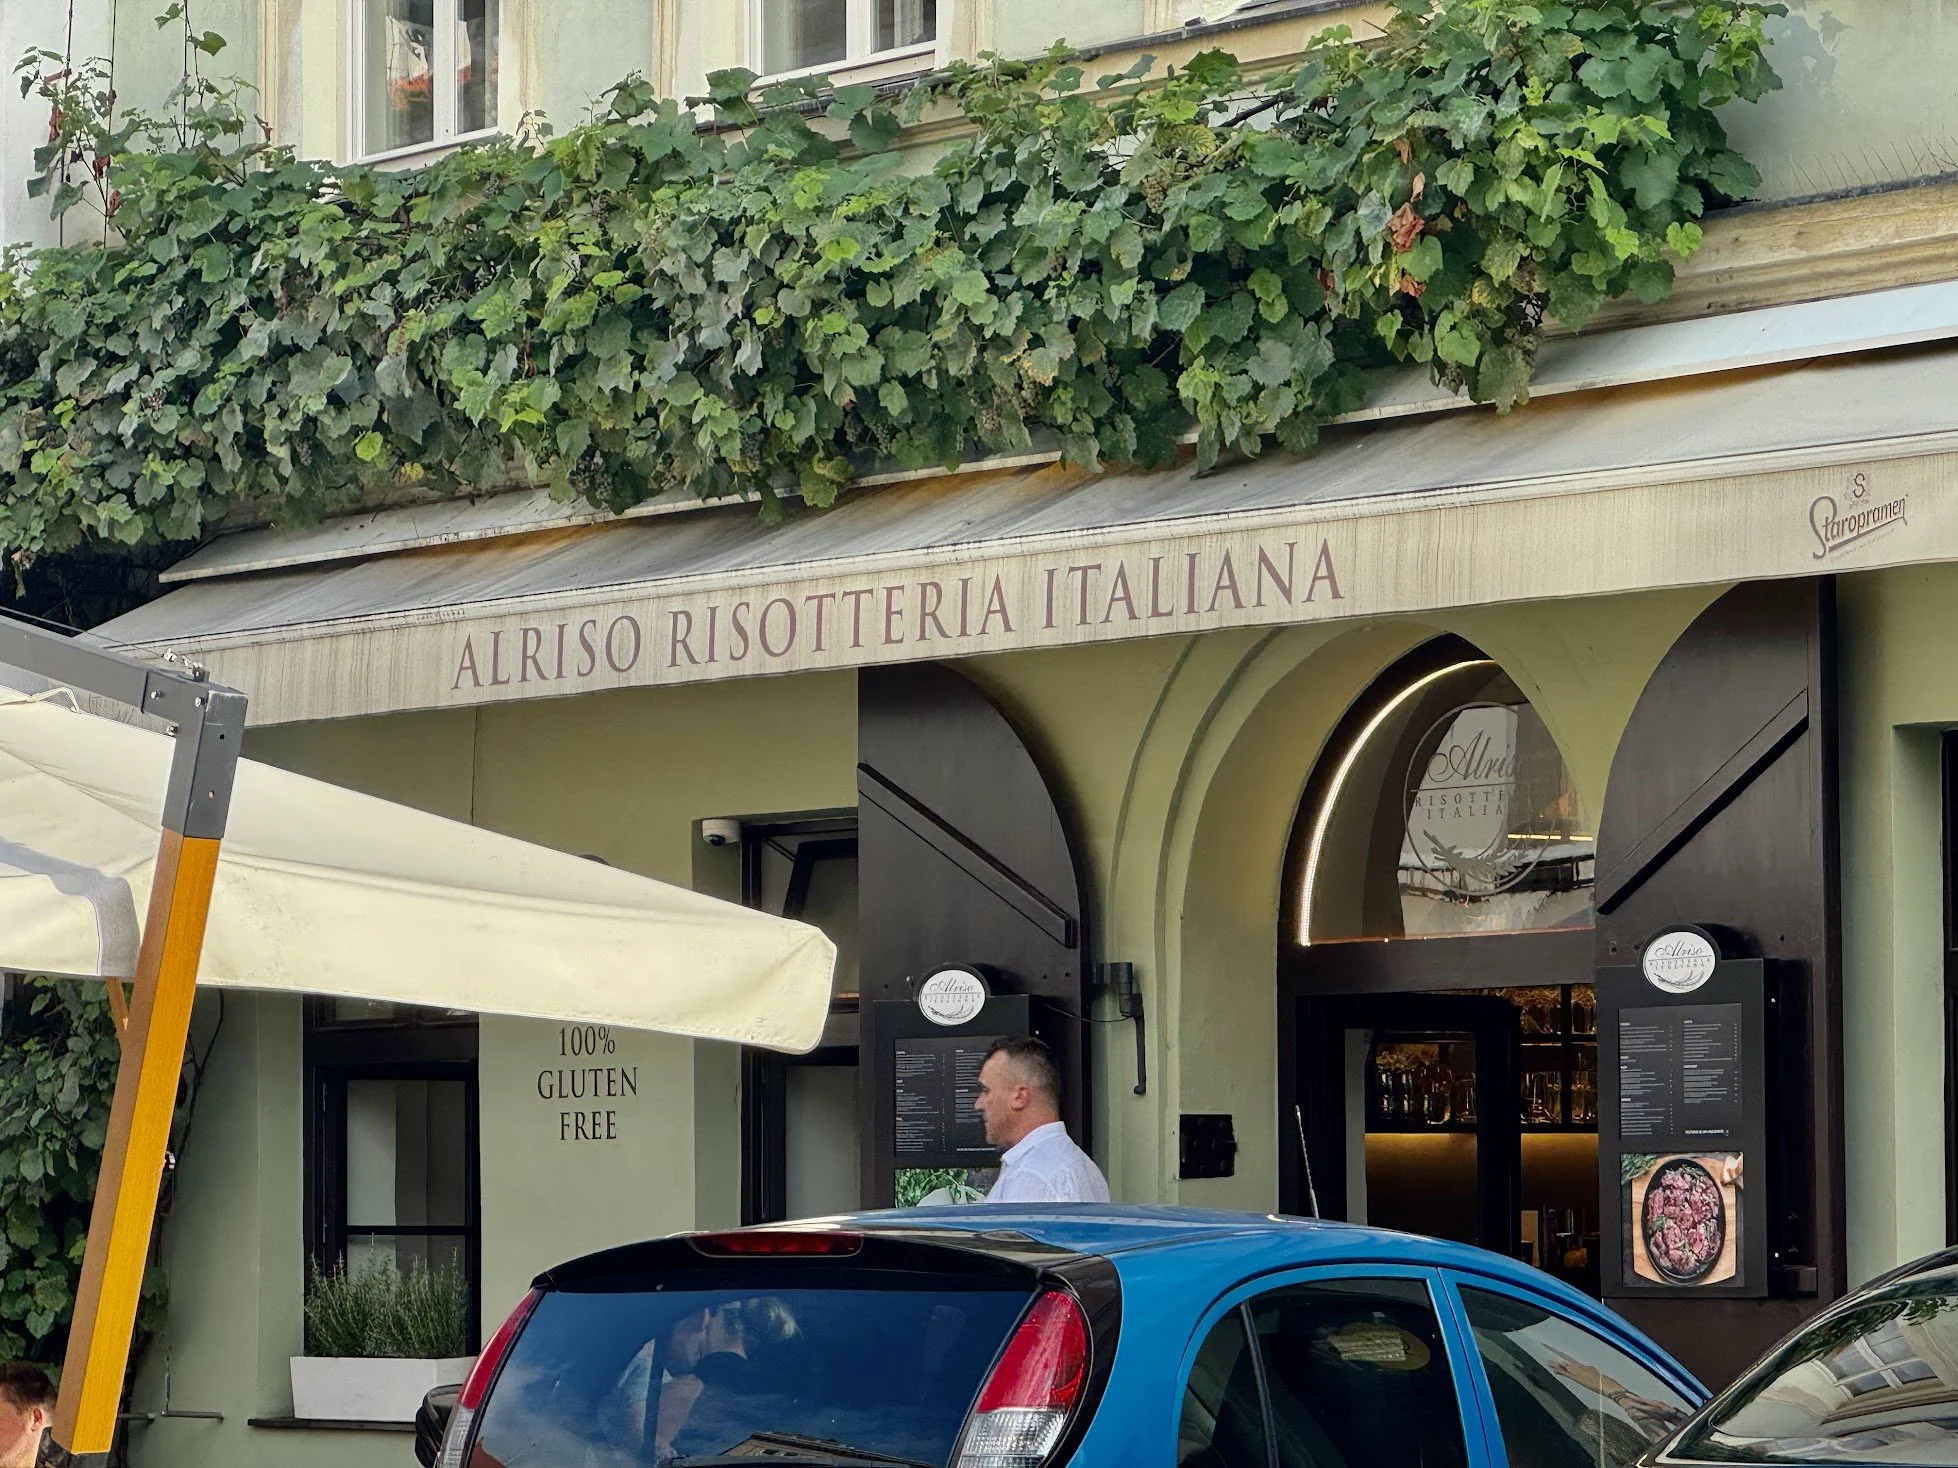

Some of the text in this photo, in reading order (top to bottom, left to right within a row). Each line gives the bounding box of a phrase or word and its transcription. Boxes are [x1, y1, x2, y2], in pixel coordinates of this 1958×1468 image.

[1809, 495, 1908, 560] Staropramen
[451, 537, 1346, 690] ALRISO RISOTTERIA ITALIANA
[559, 1025, 616, 1056] 100%
[537, 1066, 638, 1100] GLUTEN
[559, 1110, 617, 1141] FREE
